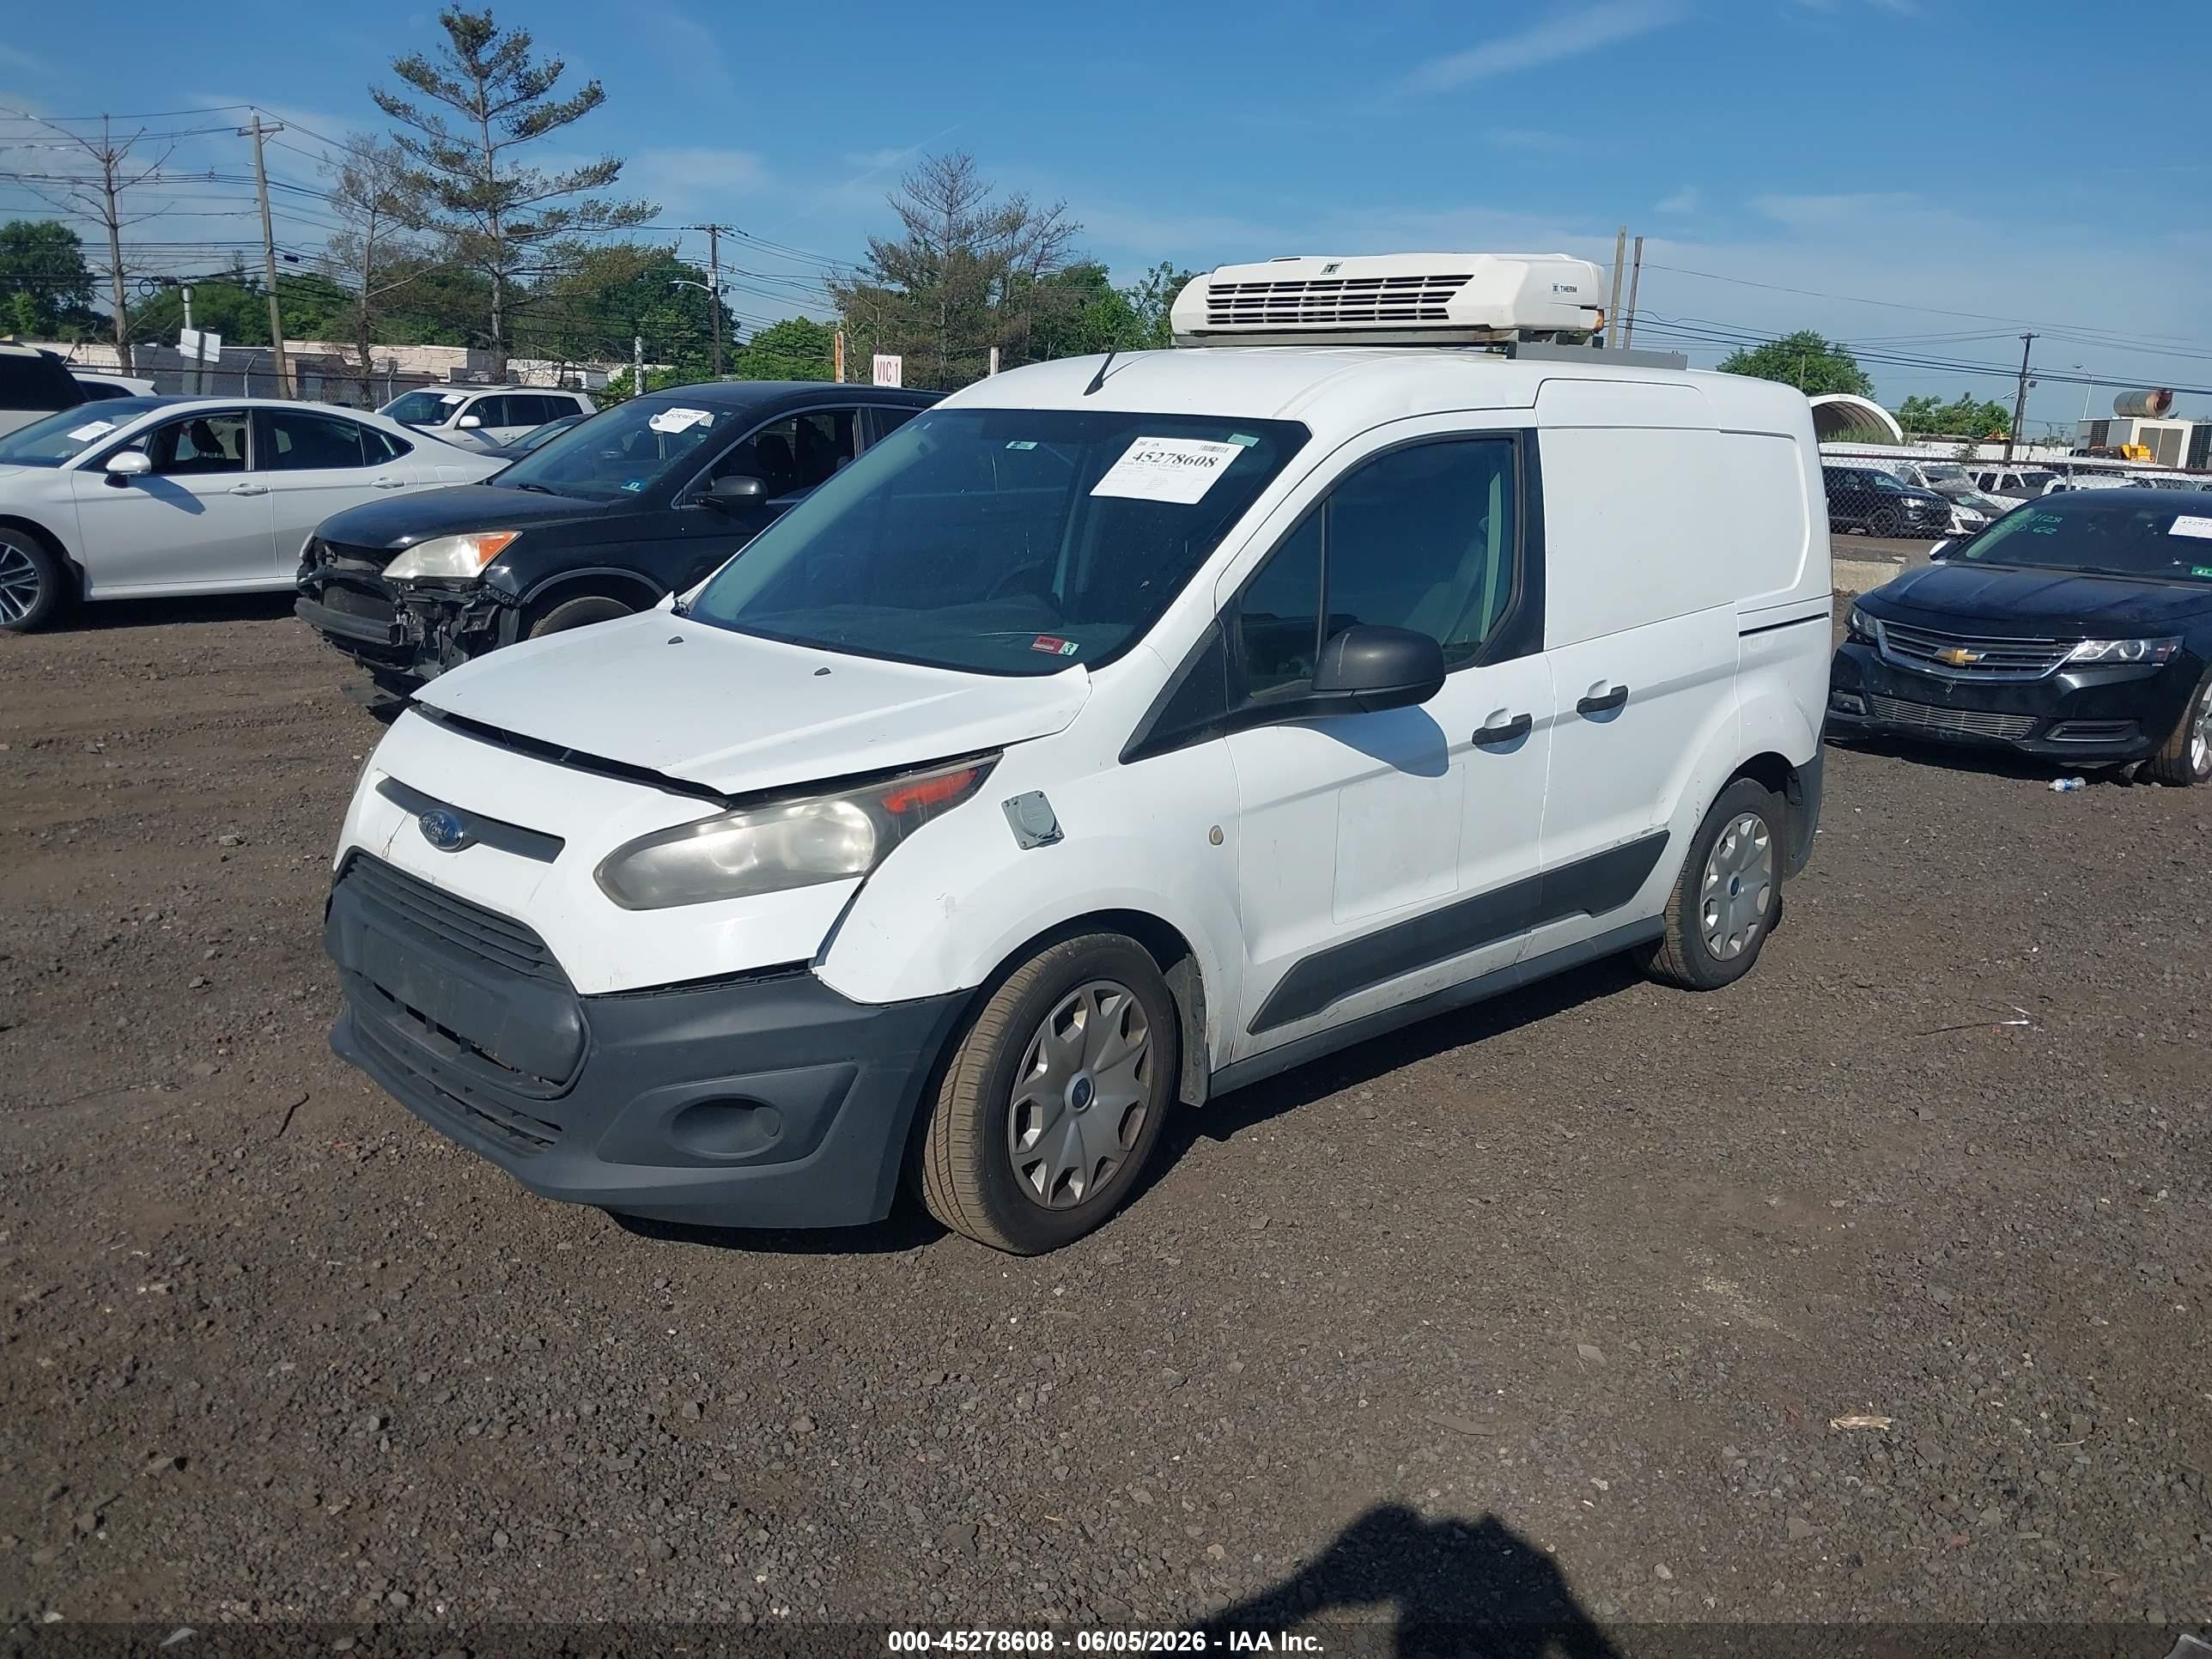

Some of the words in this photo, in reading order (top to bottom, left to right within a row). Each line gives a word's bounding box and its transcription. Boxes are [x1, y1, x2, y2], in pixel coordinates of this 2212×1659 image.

[877, 361, 892, 383] VIC
[895, 362, 898, 383] 1
[1133, 451, 1218, 468] 45278608
